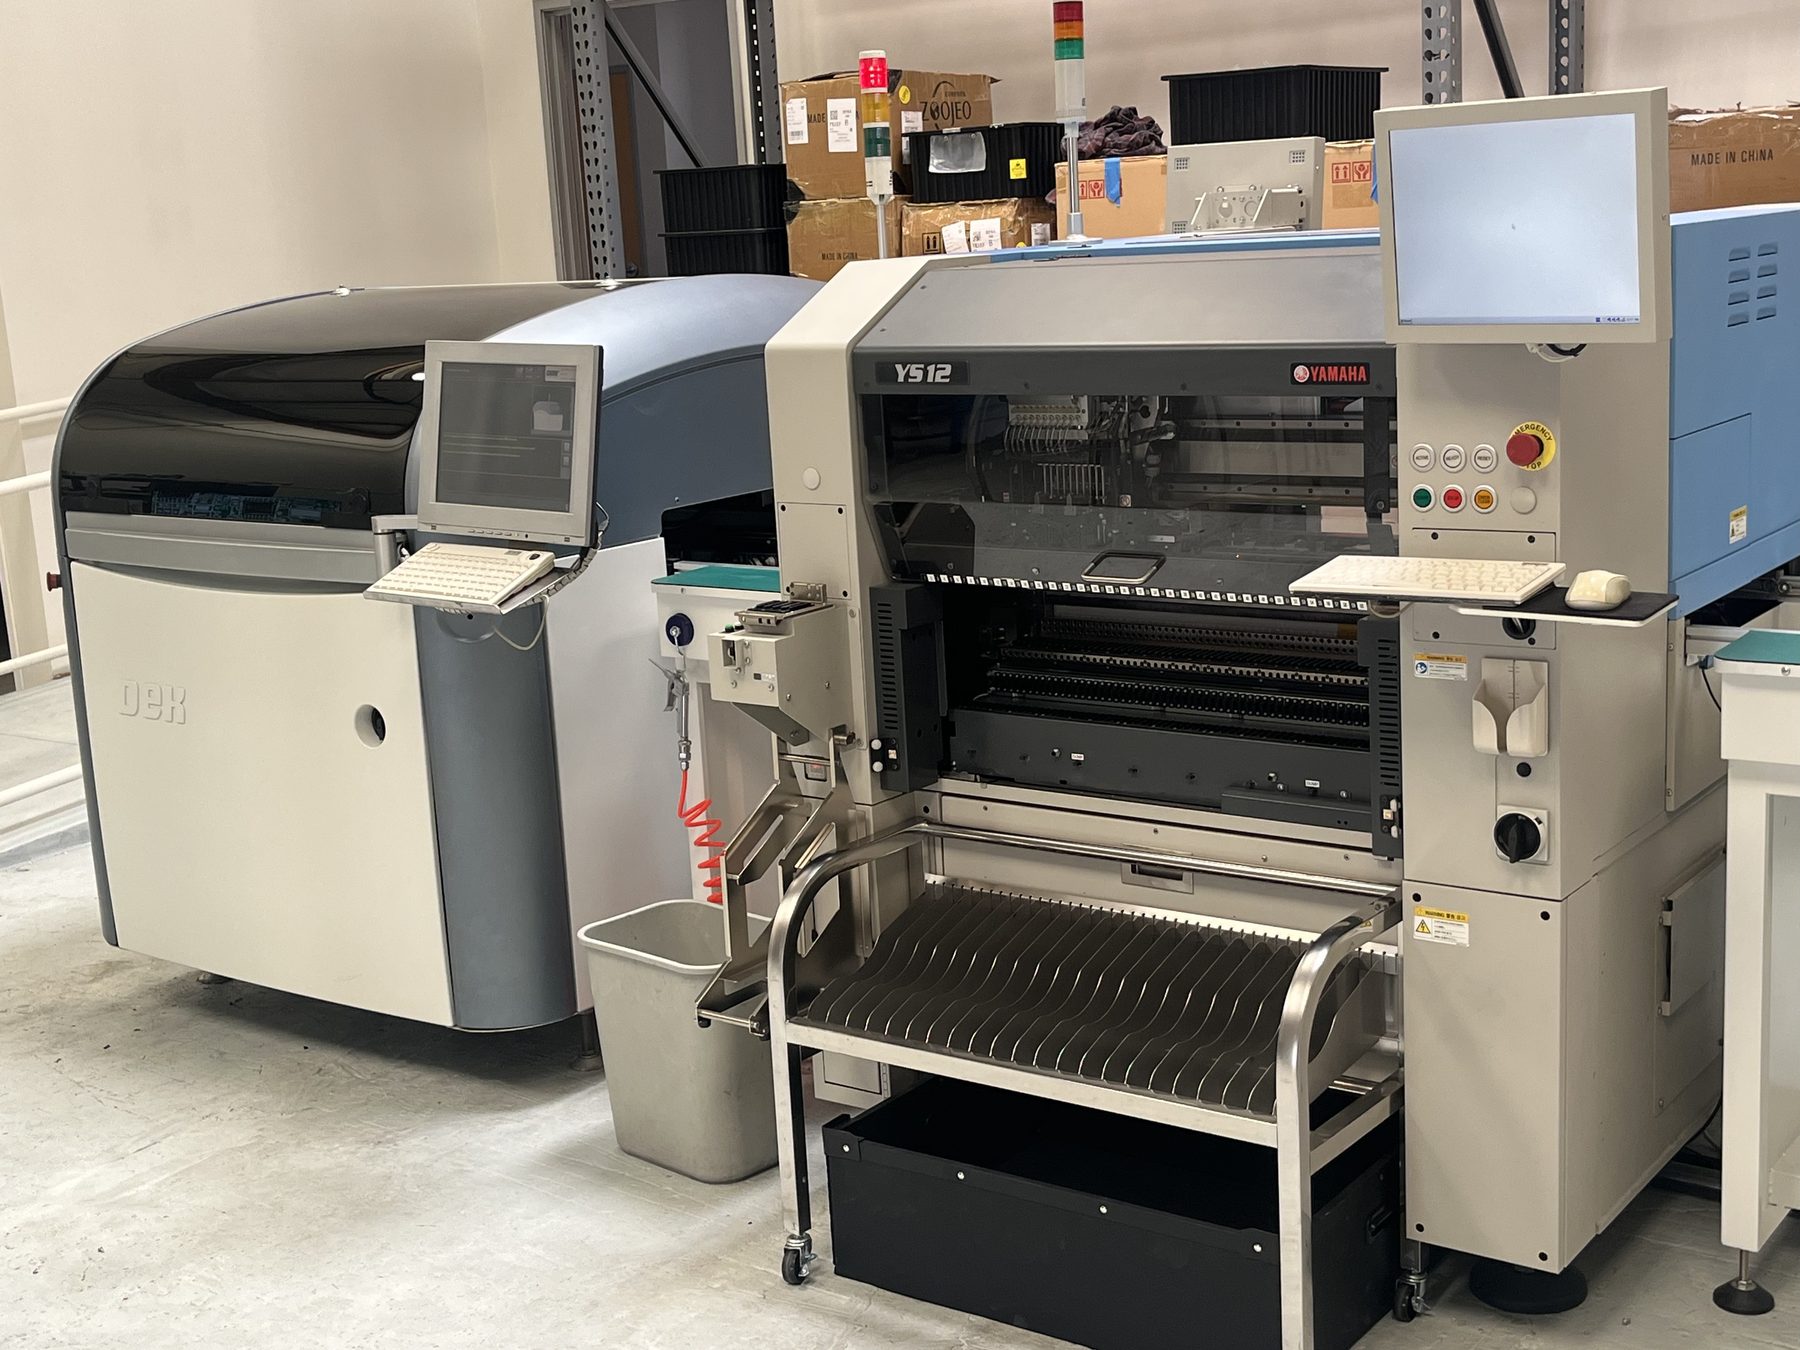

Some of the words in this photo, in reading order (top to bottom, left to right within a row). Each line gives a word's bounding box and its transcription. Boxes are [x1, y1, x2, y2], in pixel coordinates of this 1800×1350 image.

[808, 113, 826, 123] MADE
[1691, 152, 1721, 165] MADE
[1725, 151, 1736, 163] IN
[1741, 148, 1774, 163] CHINA
[894, 363, 952, 383] YS12
[1310, 366, 1367, 382] YAMAHA
